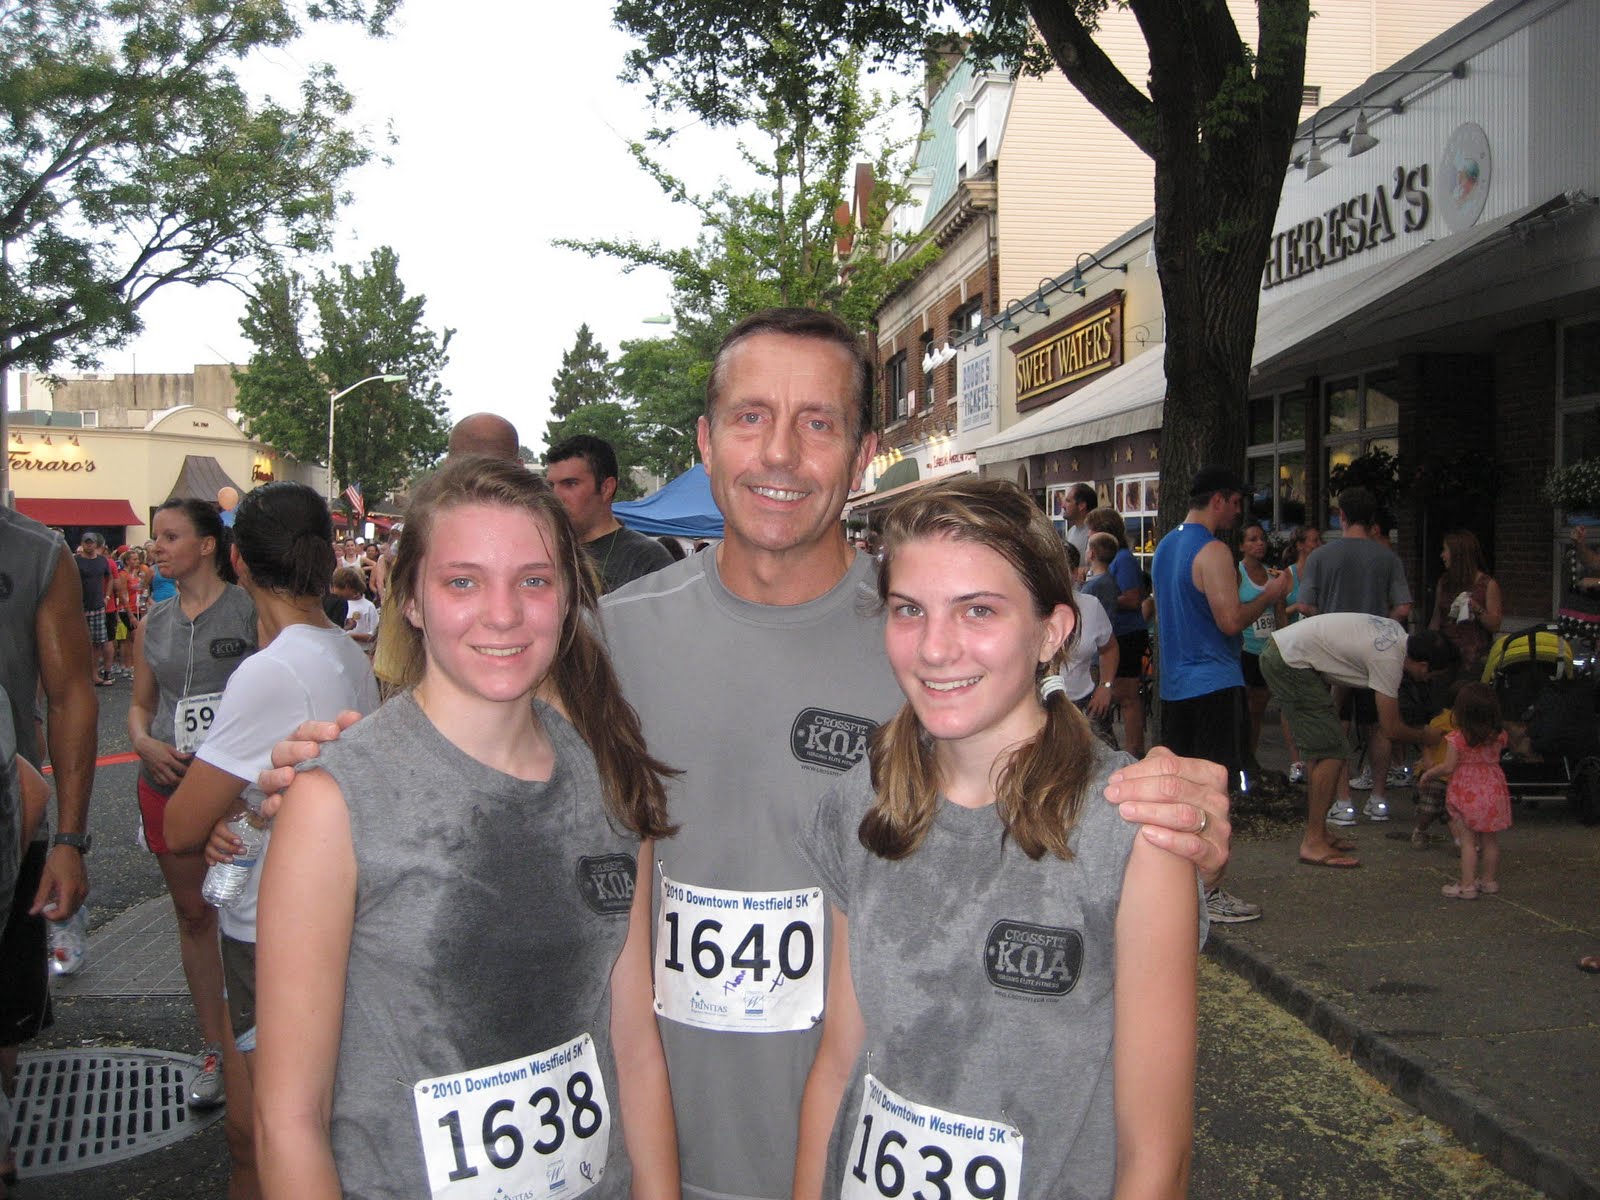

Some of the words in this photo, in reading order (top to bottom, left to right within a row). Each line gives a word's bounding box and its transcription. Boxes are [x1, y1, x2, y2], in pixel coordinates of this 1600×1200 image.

[1262, 164, 1429, 290] HERESA'S
[1016, 348, 1054, 394] SWEET
[1057, 316, 1112, 377] WATERS
[8, 450, 96, 473] Ferraro's
[184, 706, 215, 733] 59
[804, 724, 868, 760] KOA
[591, 871, 635, 900] KOA
[665, 885, 684, 902] 2010
[686, 890, 739, 910] Downtown
[742, 896, 793, 911] Westfield
[795, 894, 809, 908] 5K
[665, 911, 815, 982] 1640
[994, 940, 1072, 981] KOA
[690, 1000, 728, 1014] TRINITAS
[432, 1080, 462, 1100] 2010
[465, 1067, 528, 1093] Downtown
[529, 1051, 572, 1077] Westfield
[572, 1041, 584, 1059] 5K
[438, 1071, 603, 1182] 1638
[881, 1095, 926, 1129] Downtown
[929, 1114, 985, 1141] Westfield
[988, 1127, 1007, 1144] 5K
[852, 1114, 1007, 1200] 1639
